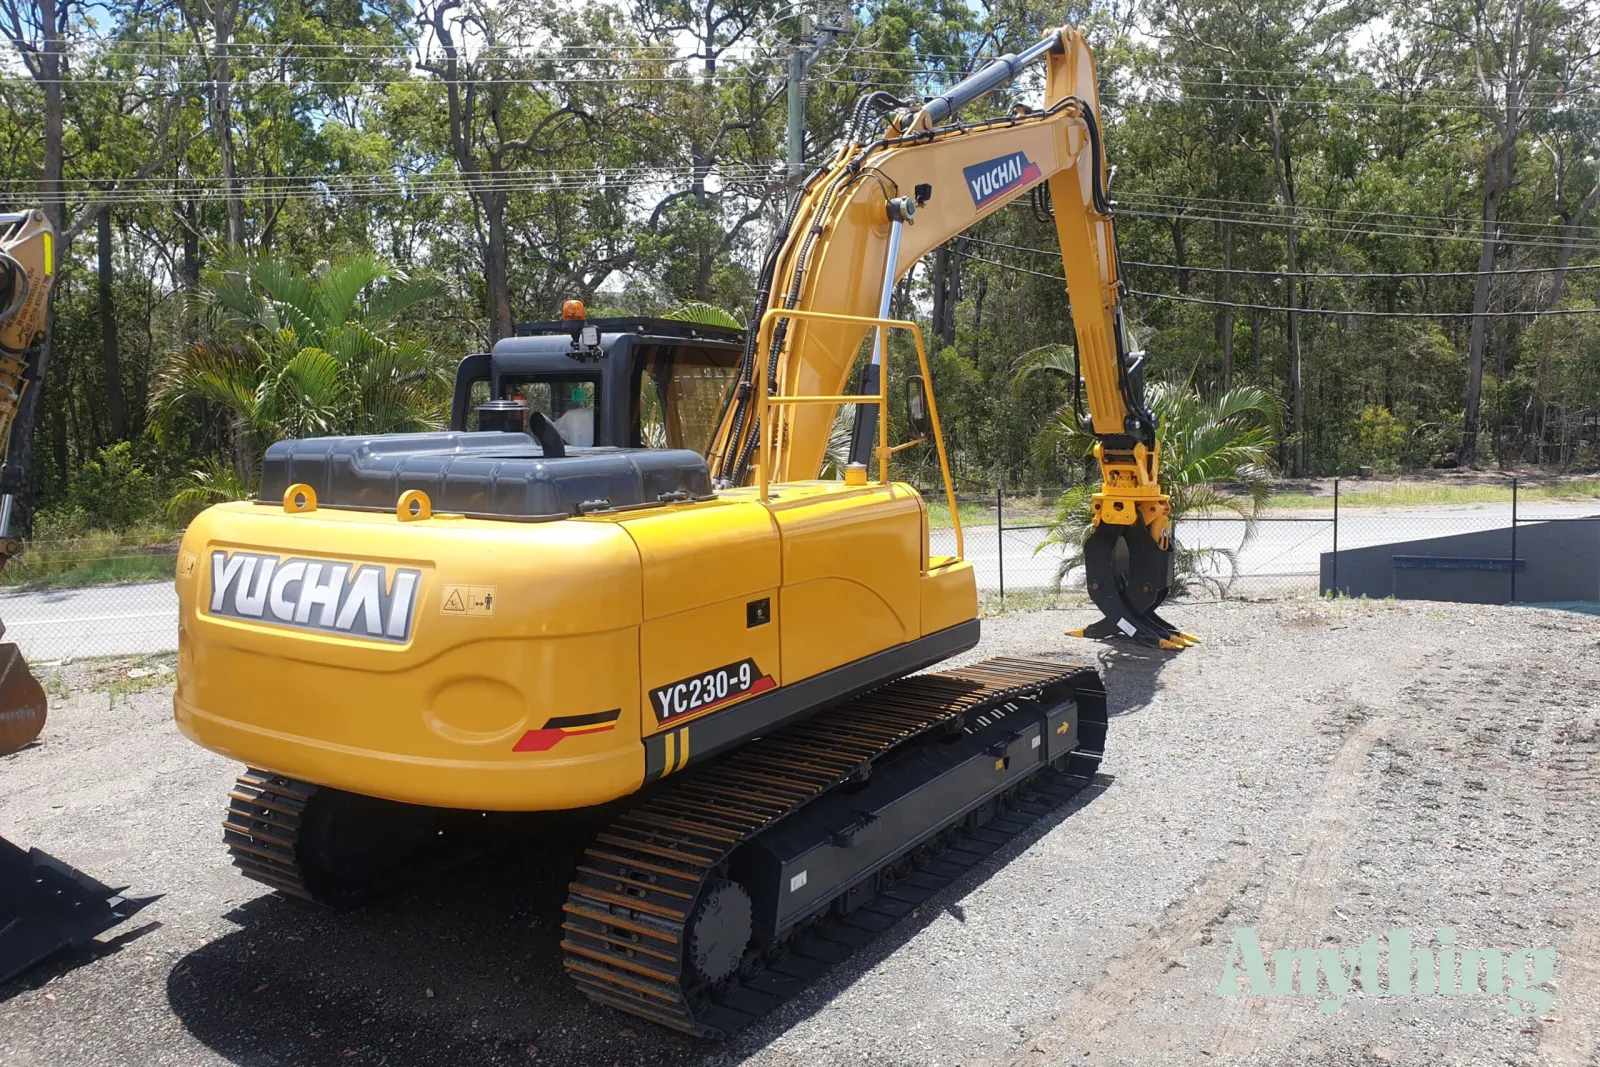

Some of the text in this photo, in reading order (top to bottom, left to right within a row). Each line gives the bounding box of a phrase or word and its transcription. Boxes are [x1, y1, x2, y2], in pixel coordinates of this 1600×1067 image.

[971, 155, 1022, 200] YUCHAI
[210, 552, 418, 639] YUCHAI
[657, 662, 751, 718] YC230-9
